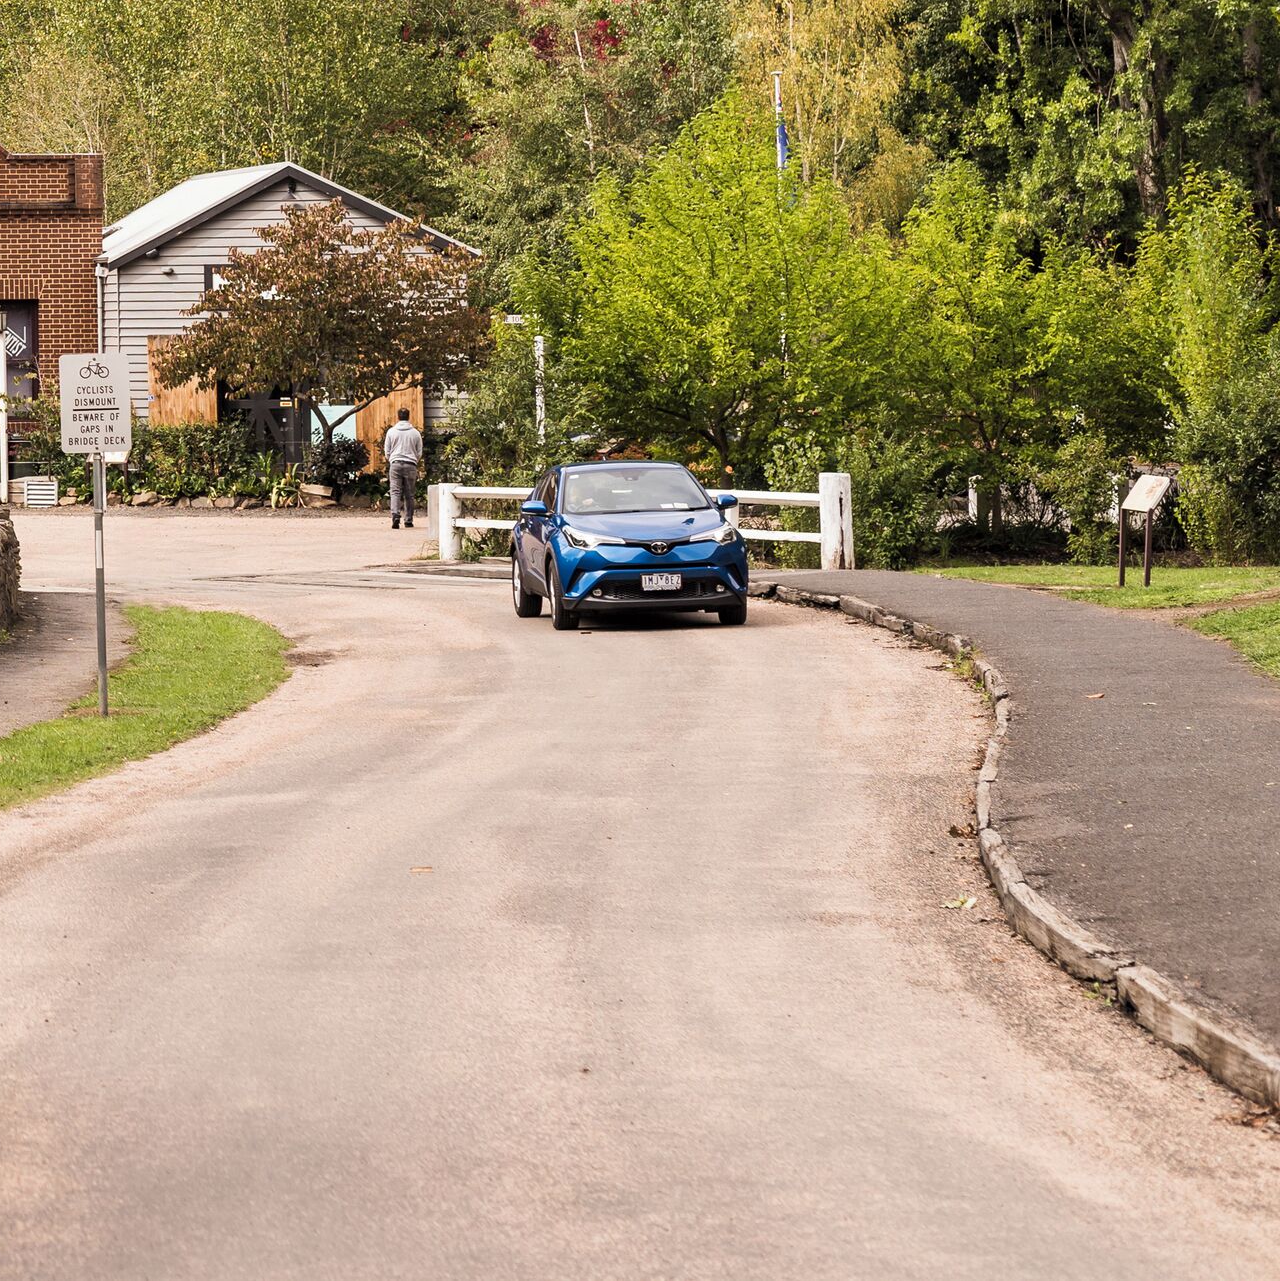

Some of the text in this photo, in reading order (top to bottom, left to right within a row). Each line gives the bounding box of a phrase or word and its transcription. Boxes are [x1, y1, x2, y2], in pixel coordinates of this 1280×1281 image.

[76, 385, 114, 395] CYCLISTS
[74, 397, 116, 406] DISMOUNT
[72, 412, 120, 421] BEWARE OF
[80, 424, 114, 433] GAPS IN
[68, 436, 126, 445] BRIDGE DECK
